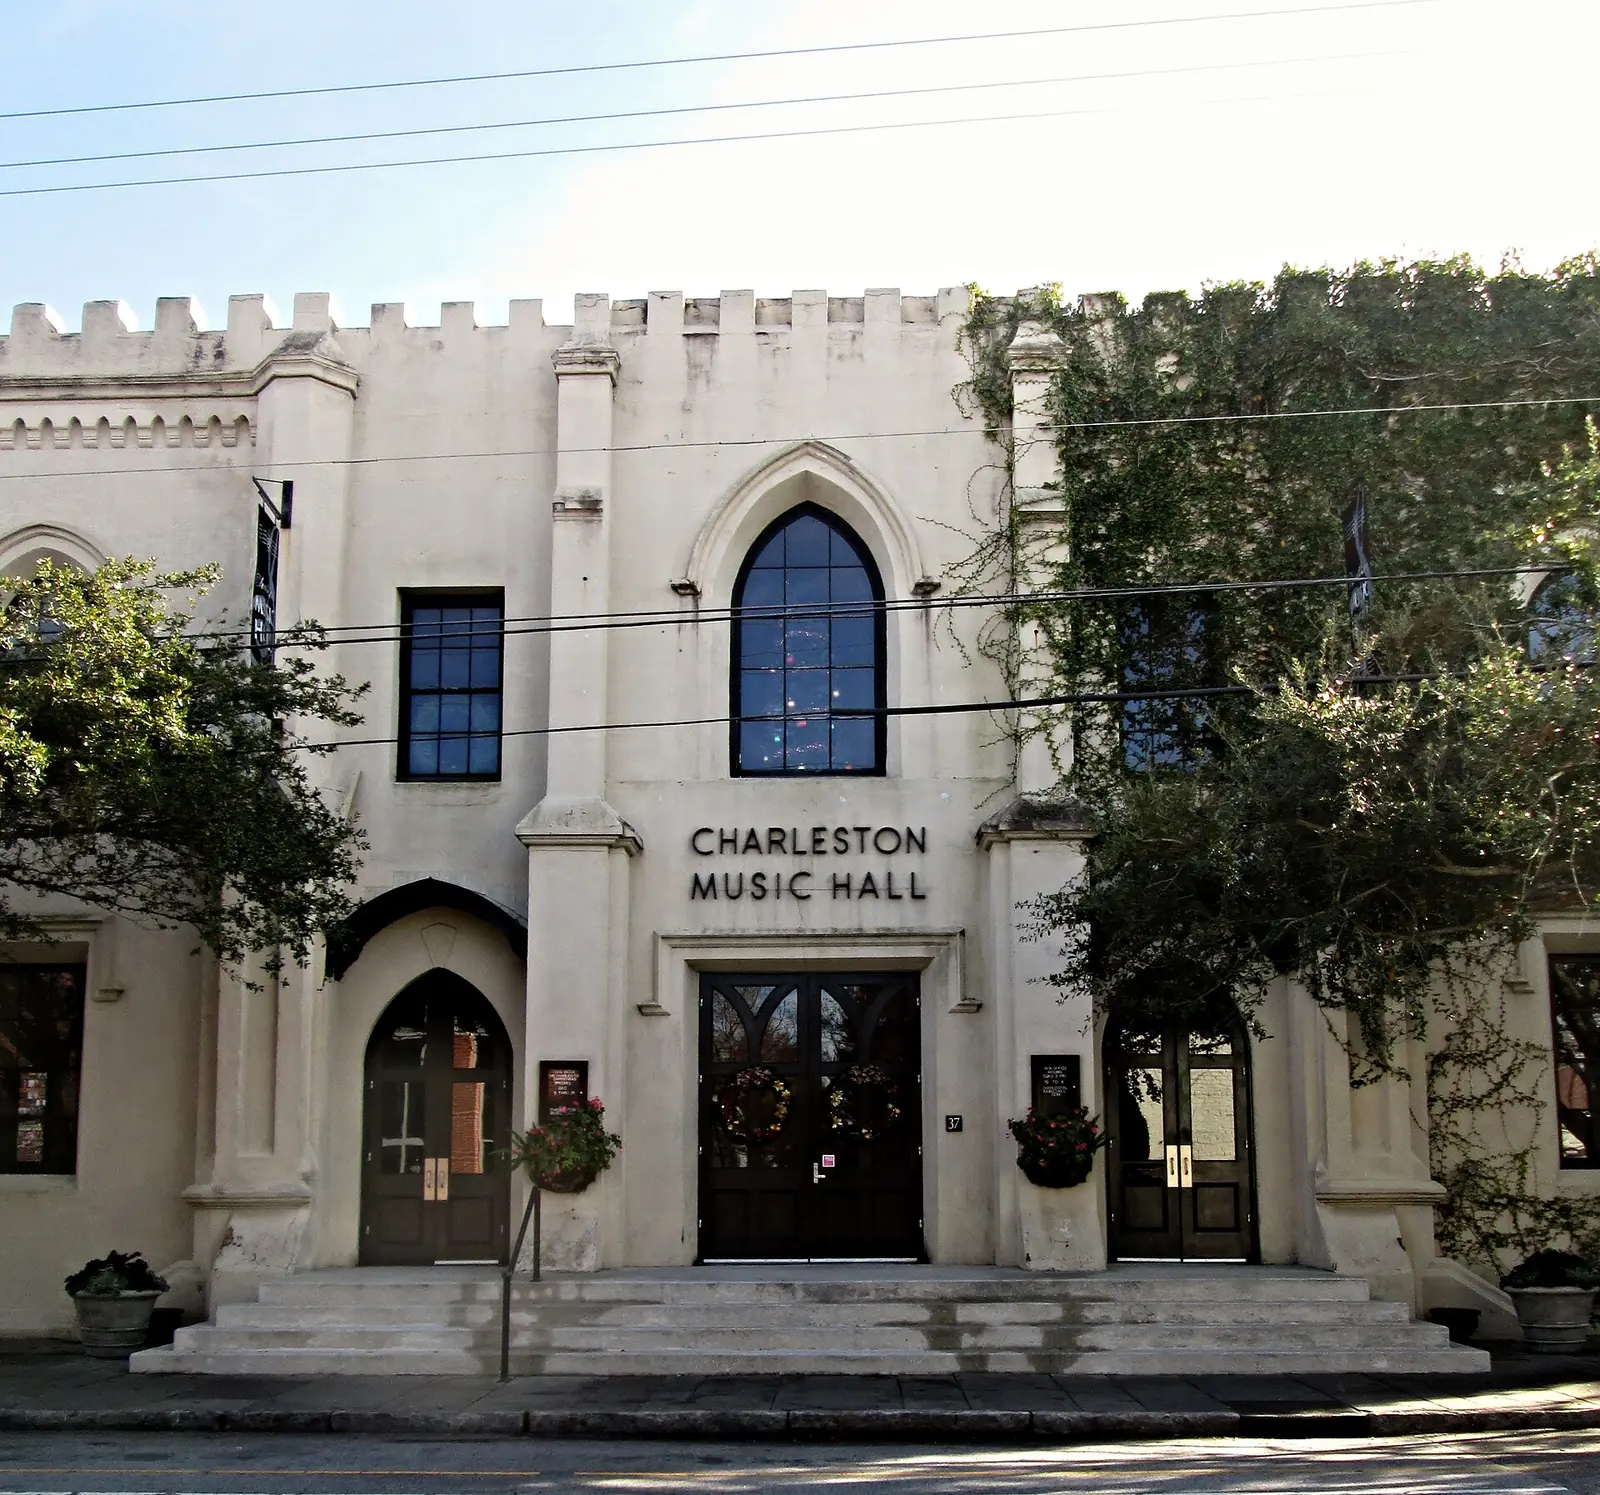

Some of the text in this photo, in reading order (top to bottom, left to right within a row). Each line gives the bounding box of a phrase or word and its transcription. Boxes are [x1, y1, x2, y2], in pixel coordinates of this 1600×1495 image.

[692, 826, 926, 856] CHARLESTON
[691, 871, 926, 900] MUSIC HALL
[948, 1117, 960, 1130] 37
